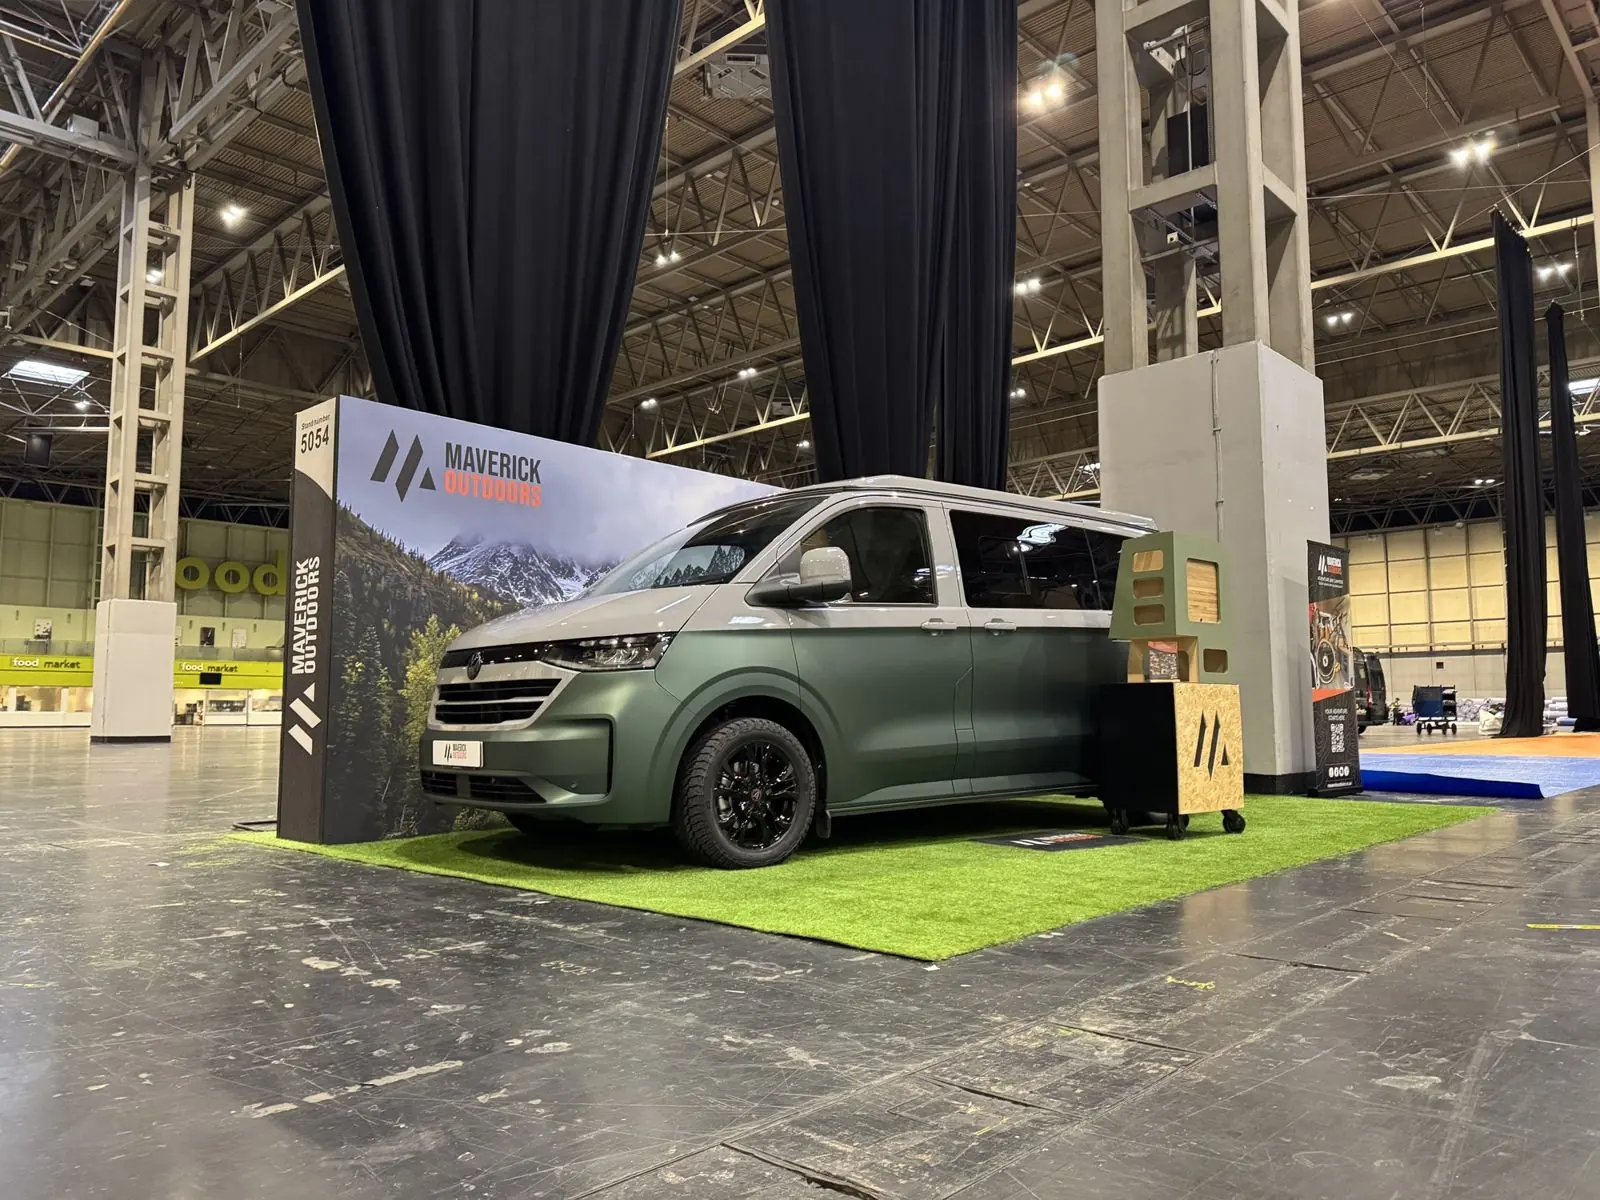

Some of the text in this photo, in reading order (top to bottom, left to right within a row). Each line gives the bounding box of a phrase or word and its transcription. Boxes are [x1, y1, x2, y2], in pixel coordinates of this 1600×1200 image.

[300, 424, 330, 454] 5054
[301, 414, 331, 430] Stand number
[445, 442, 541, 484] MAVERICK
[444, 468, 542, 508] OUTDOORS
[291, 558, 309, 675] MAVERICK
[304, 556, 320, 674] OUTDOORS
[12, 657, 81, 669] food market
[181, 662, 238, 673] food market
